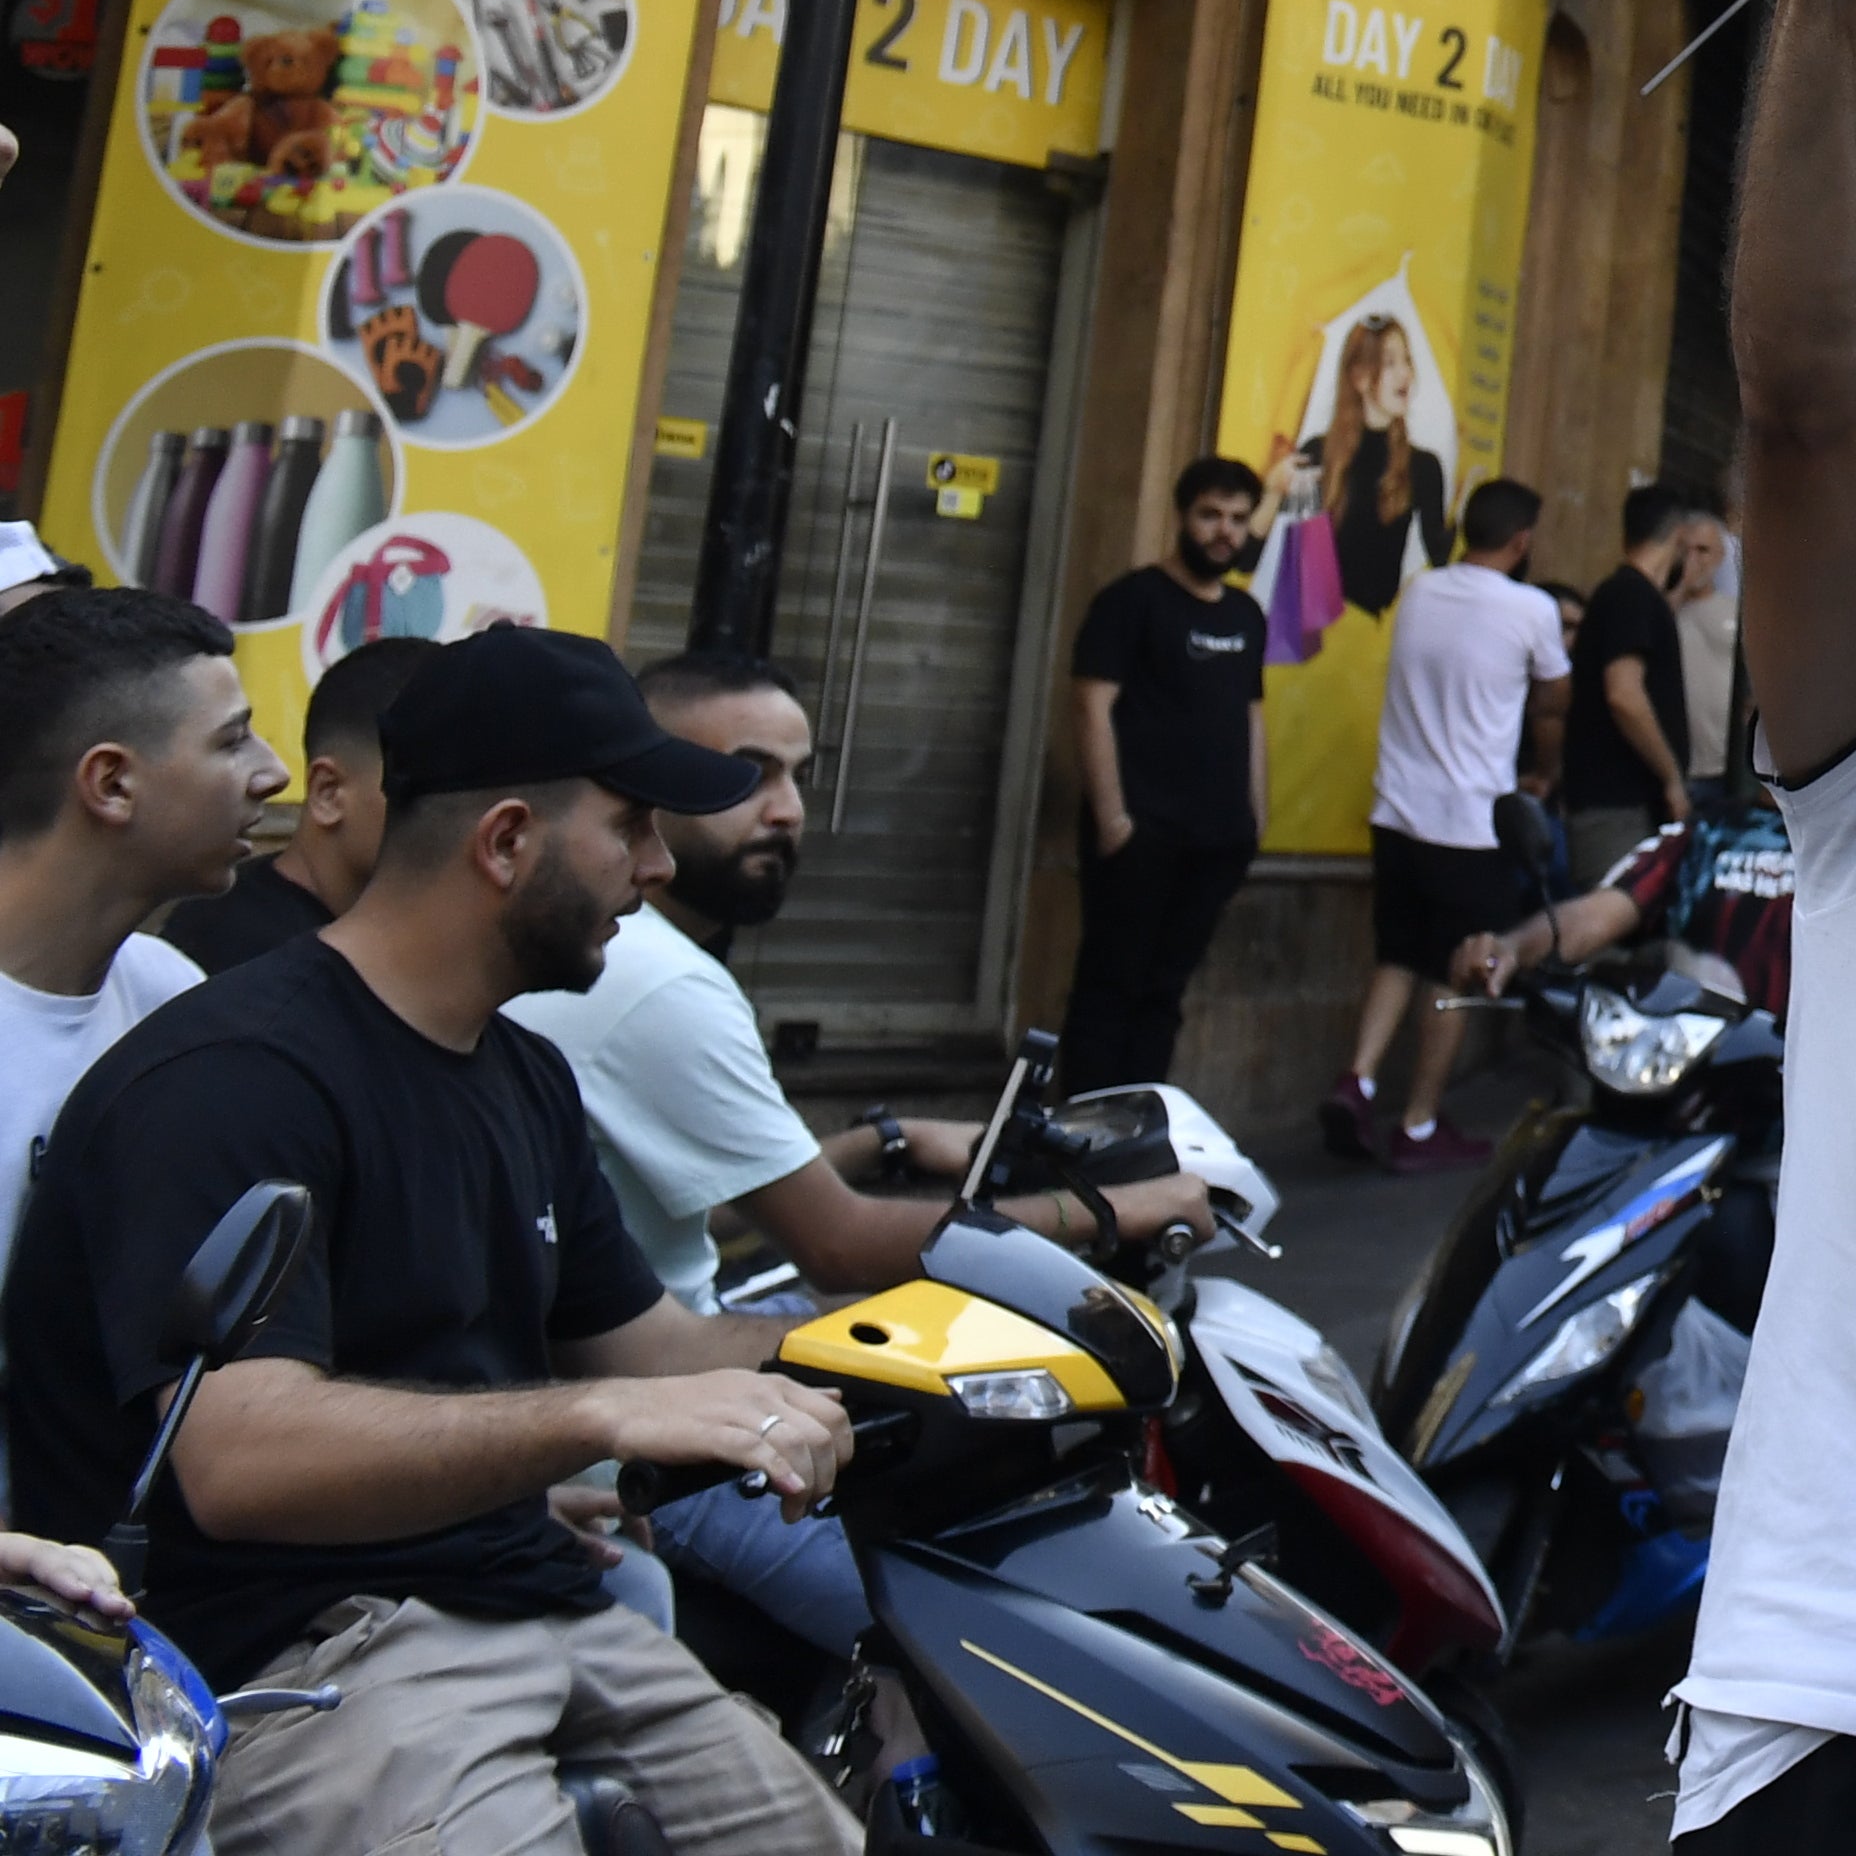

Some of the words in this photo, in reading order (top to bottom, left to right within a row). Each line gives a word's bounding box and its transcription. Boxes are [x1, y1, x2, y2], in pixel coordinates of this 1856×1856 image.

[1435, 24, 1469, 93] 2
[1311, 73, 1348, 104] ALL
[1353, 79, 1393, 112] YOU
[1395, 87, 1447, 124] NEED
